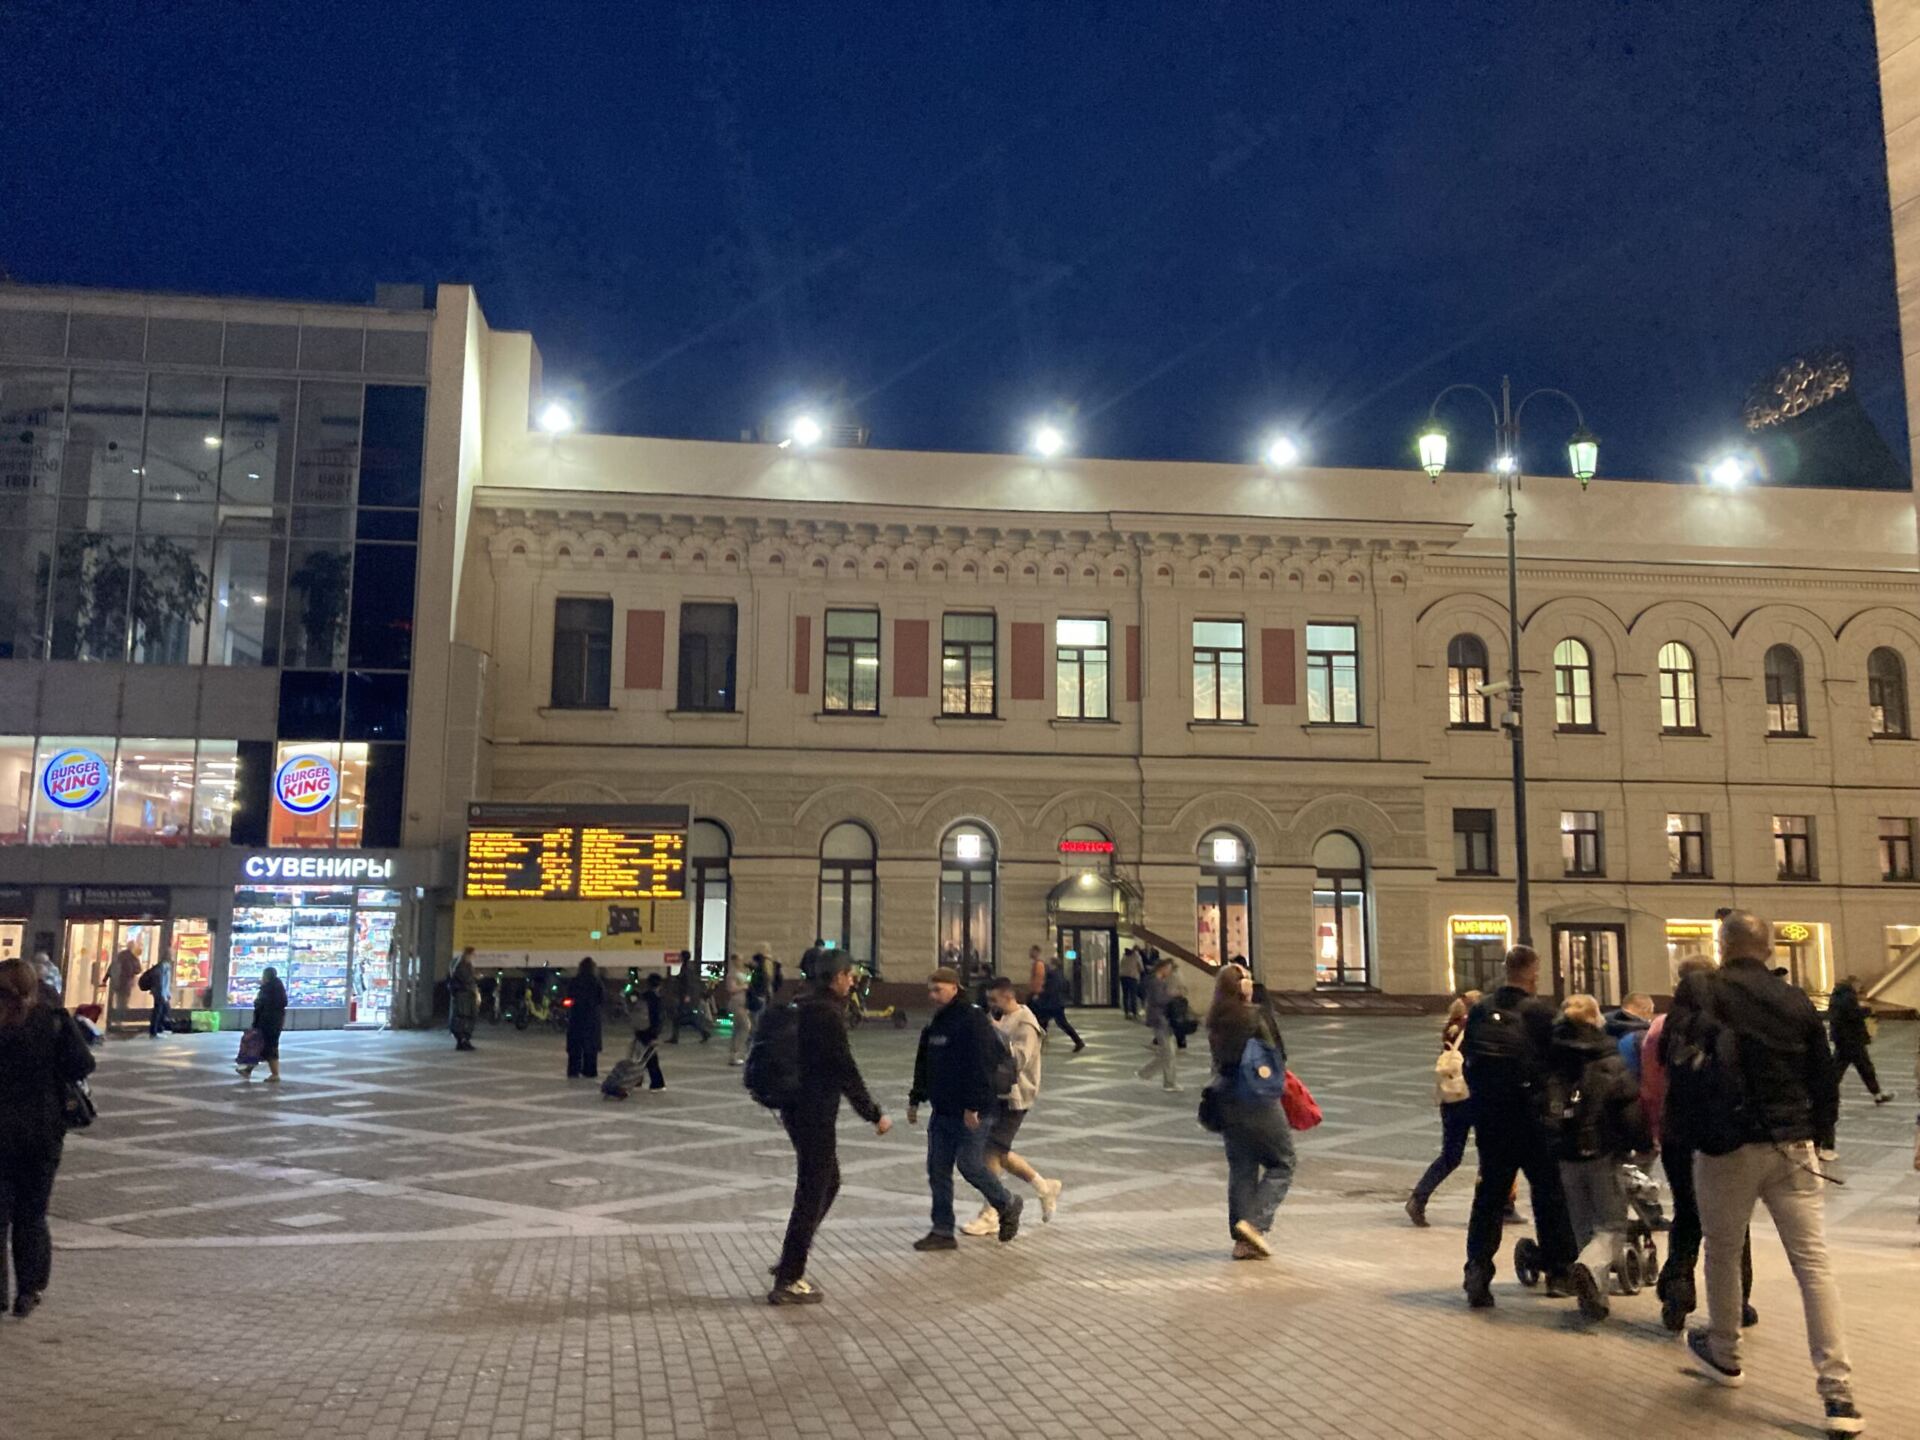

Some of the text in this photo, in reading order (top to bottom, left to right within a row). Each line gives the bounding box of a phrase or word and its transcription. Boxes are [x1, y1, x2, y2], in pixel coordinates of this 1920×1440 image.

[51, 761, 99, 781] BURGER
[283, 766, 330, 785] BURGER
[51, 773, 100, 795] KING
[283, 777, 331, 799] KING
[245, 856, 392, 878] СУВЕНИРЫ
